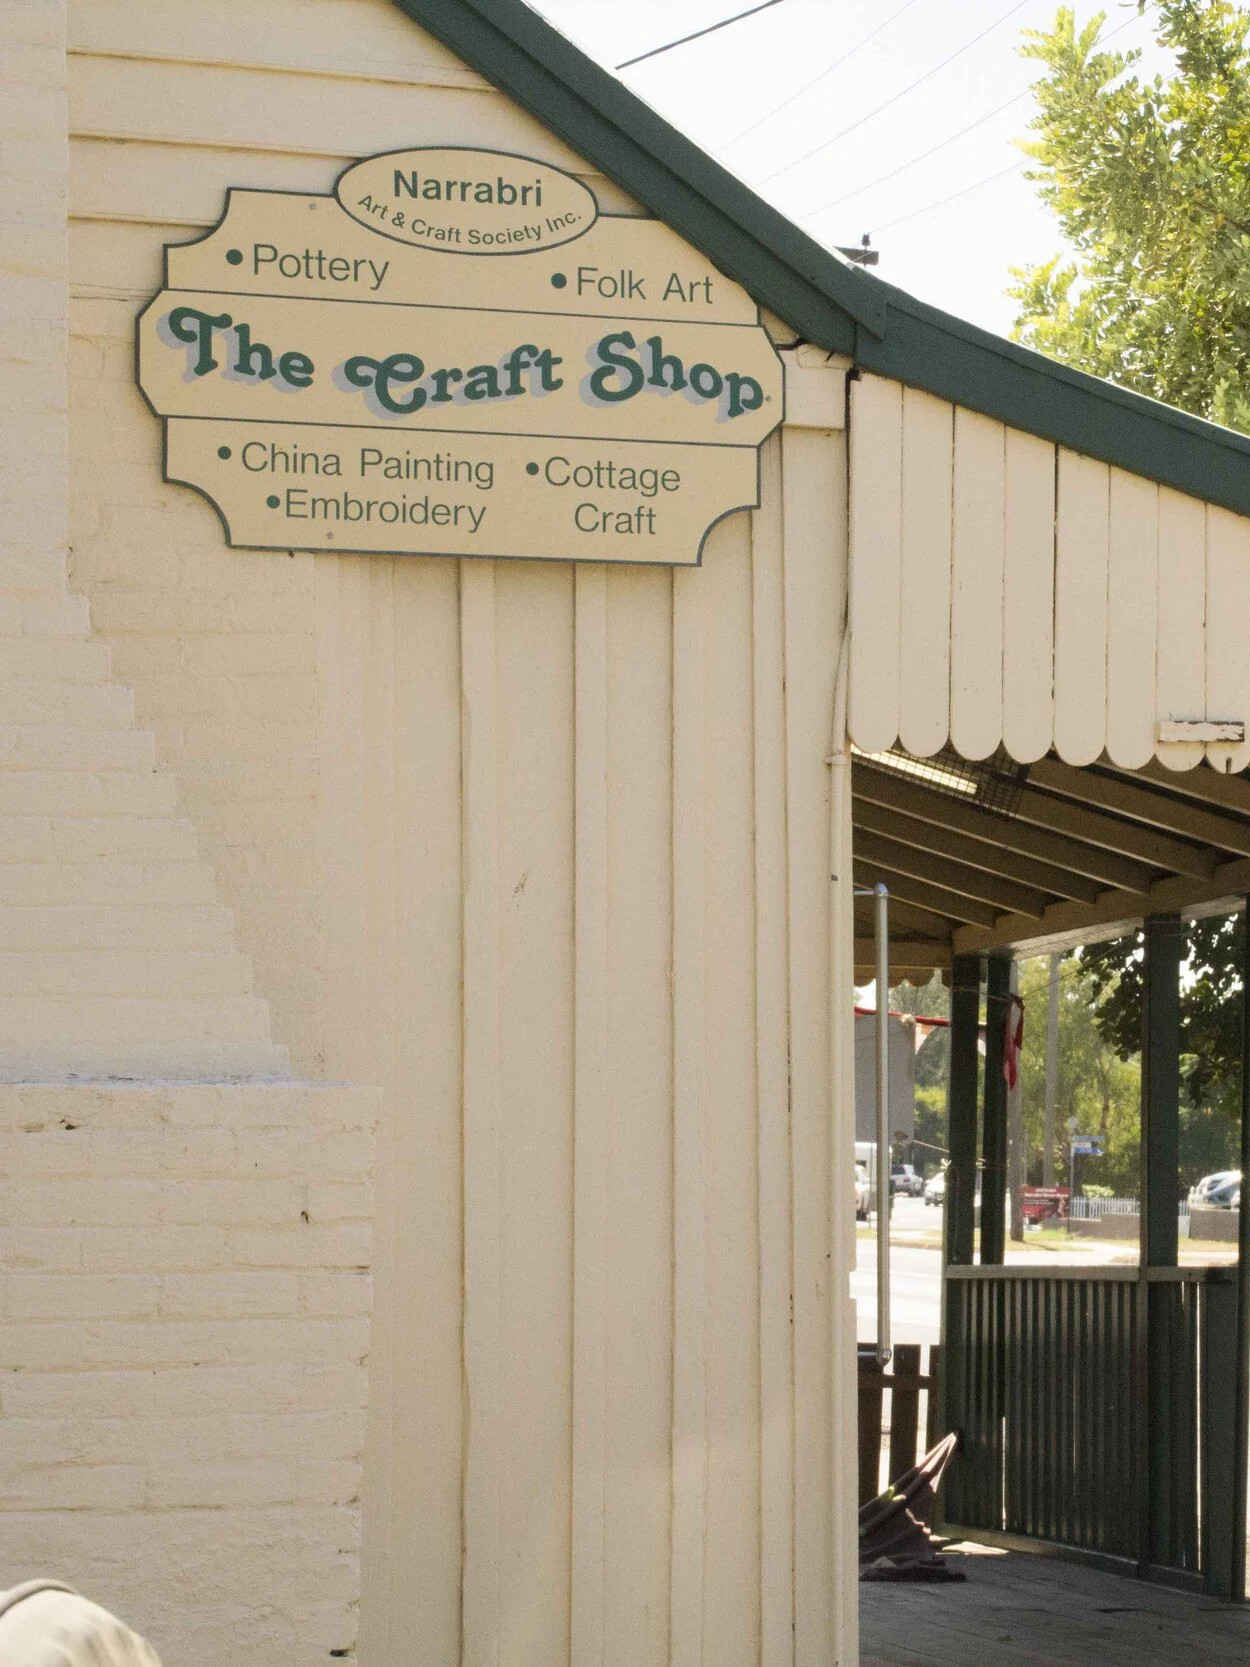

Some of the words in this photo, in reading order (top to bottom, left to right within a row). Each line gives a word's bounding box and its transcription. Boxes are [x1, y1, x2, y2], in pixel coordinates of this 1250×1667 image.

[394, 170, 541, 207] Narrabri
[358, 195, 388, 220] Art
[392, 211, 405, 229] &
[411, 219, 461, 243] Craft
[468, 225, 541, 245] Society
[546, 212, 581, 233] Inc.
[253, 243, 390, 290] Pottery
[576, 266, 646, 300] Folk
[663, 271, 713, 304] Art
[164, 306, 315, 388] The
[342, 343, 564, 415] Craft
[588, 331, 764, 418] Shop
[241, 441, 342, 477] China
[360, 448, 494, 489] Painting
[545, 456, 682, 497] Cottage
[285, 488, 486, 533] Embroidery
[574, 502, 657, 535] Craft
